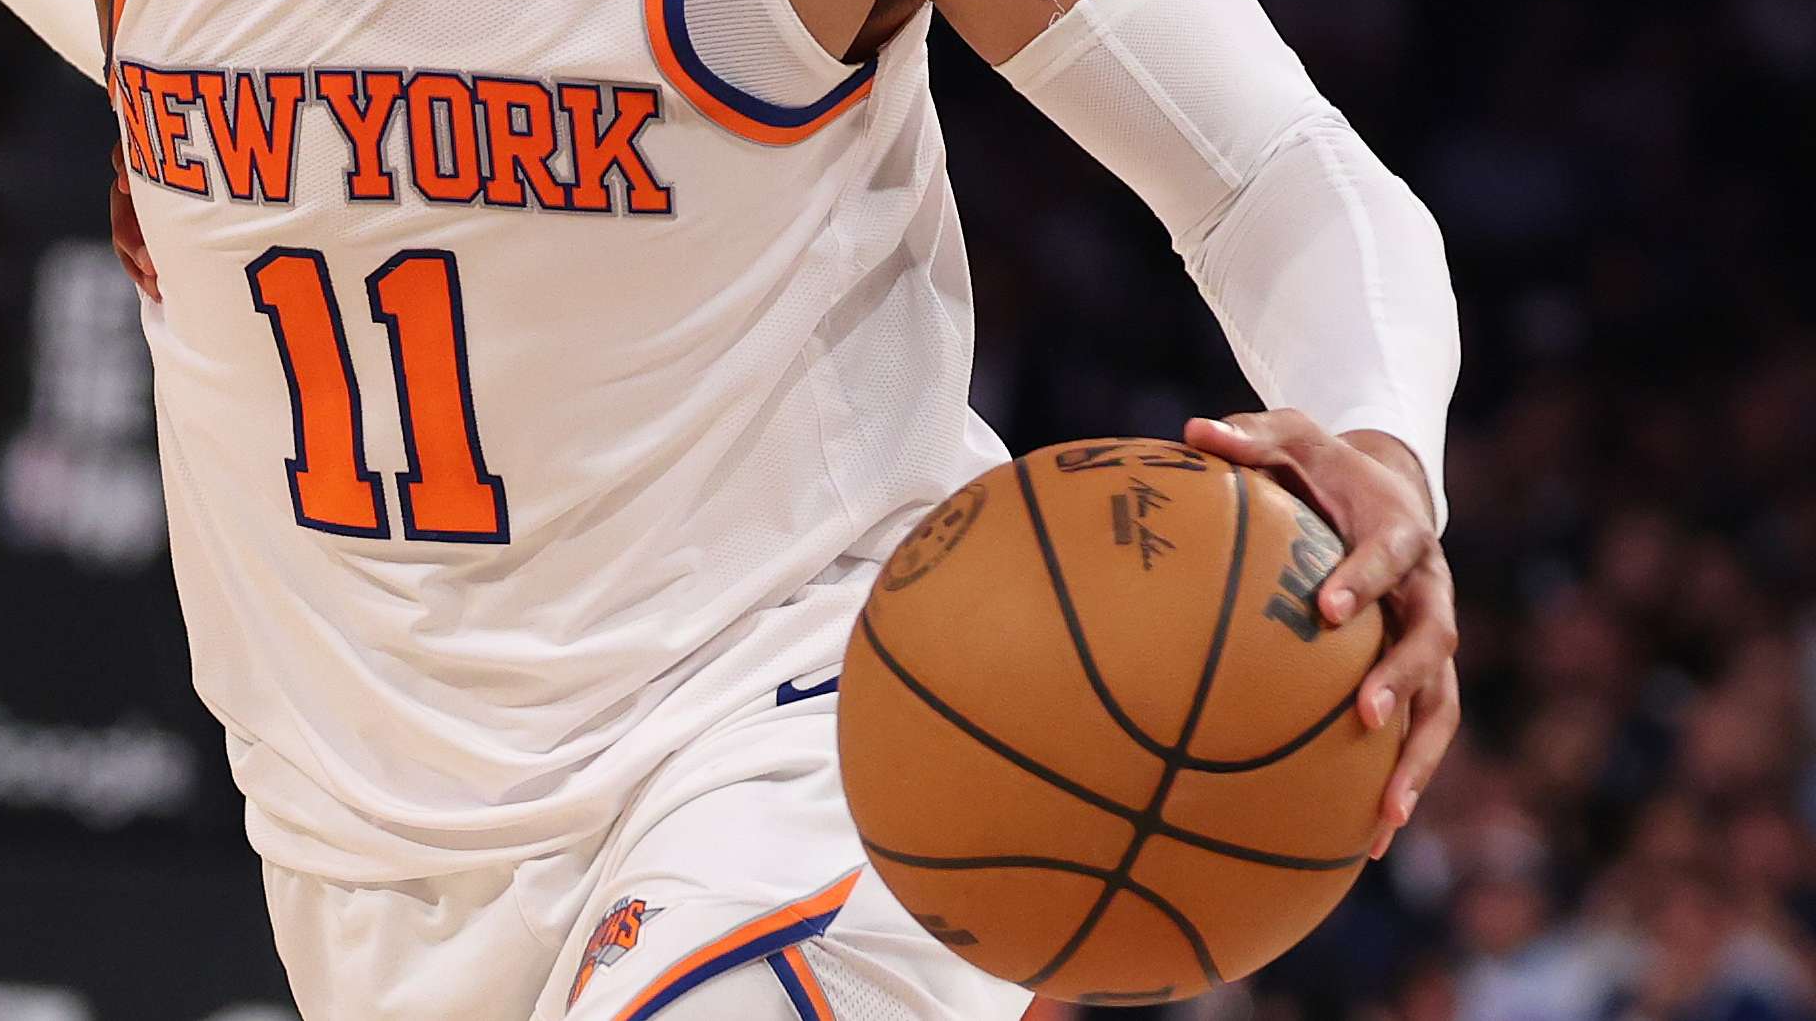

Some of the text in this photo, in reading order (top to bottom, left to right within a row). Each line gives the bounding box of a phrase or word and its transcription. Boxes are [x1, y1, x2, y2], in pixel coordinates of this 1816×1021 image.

[116, 60, 677, 217] NEW YORK
[244, 245, 511, 544] 11
